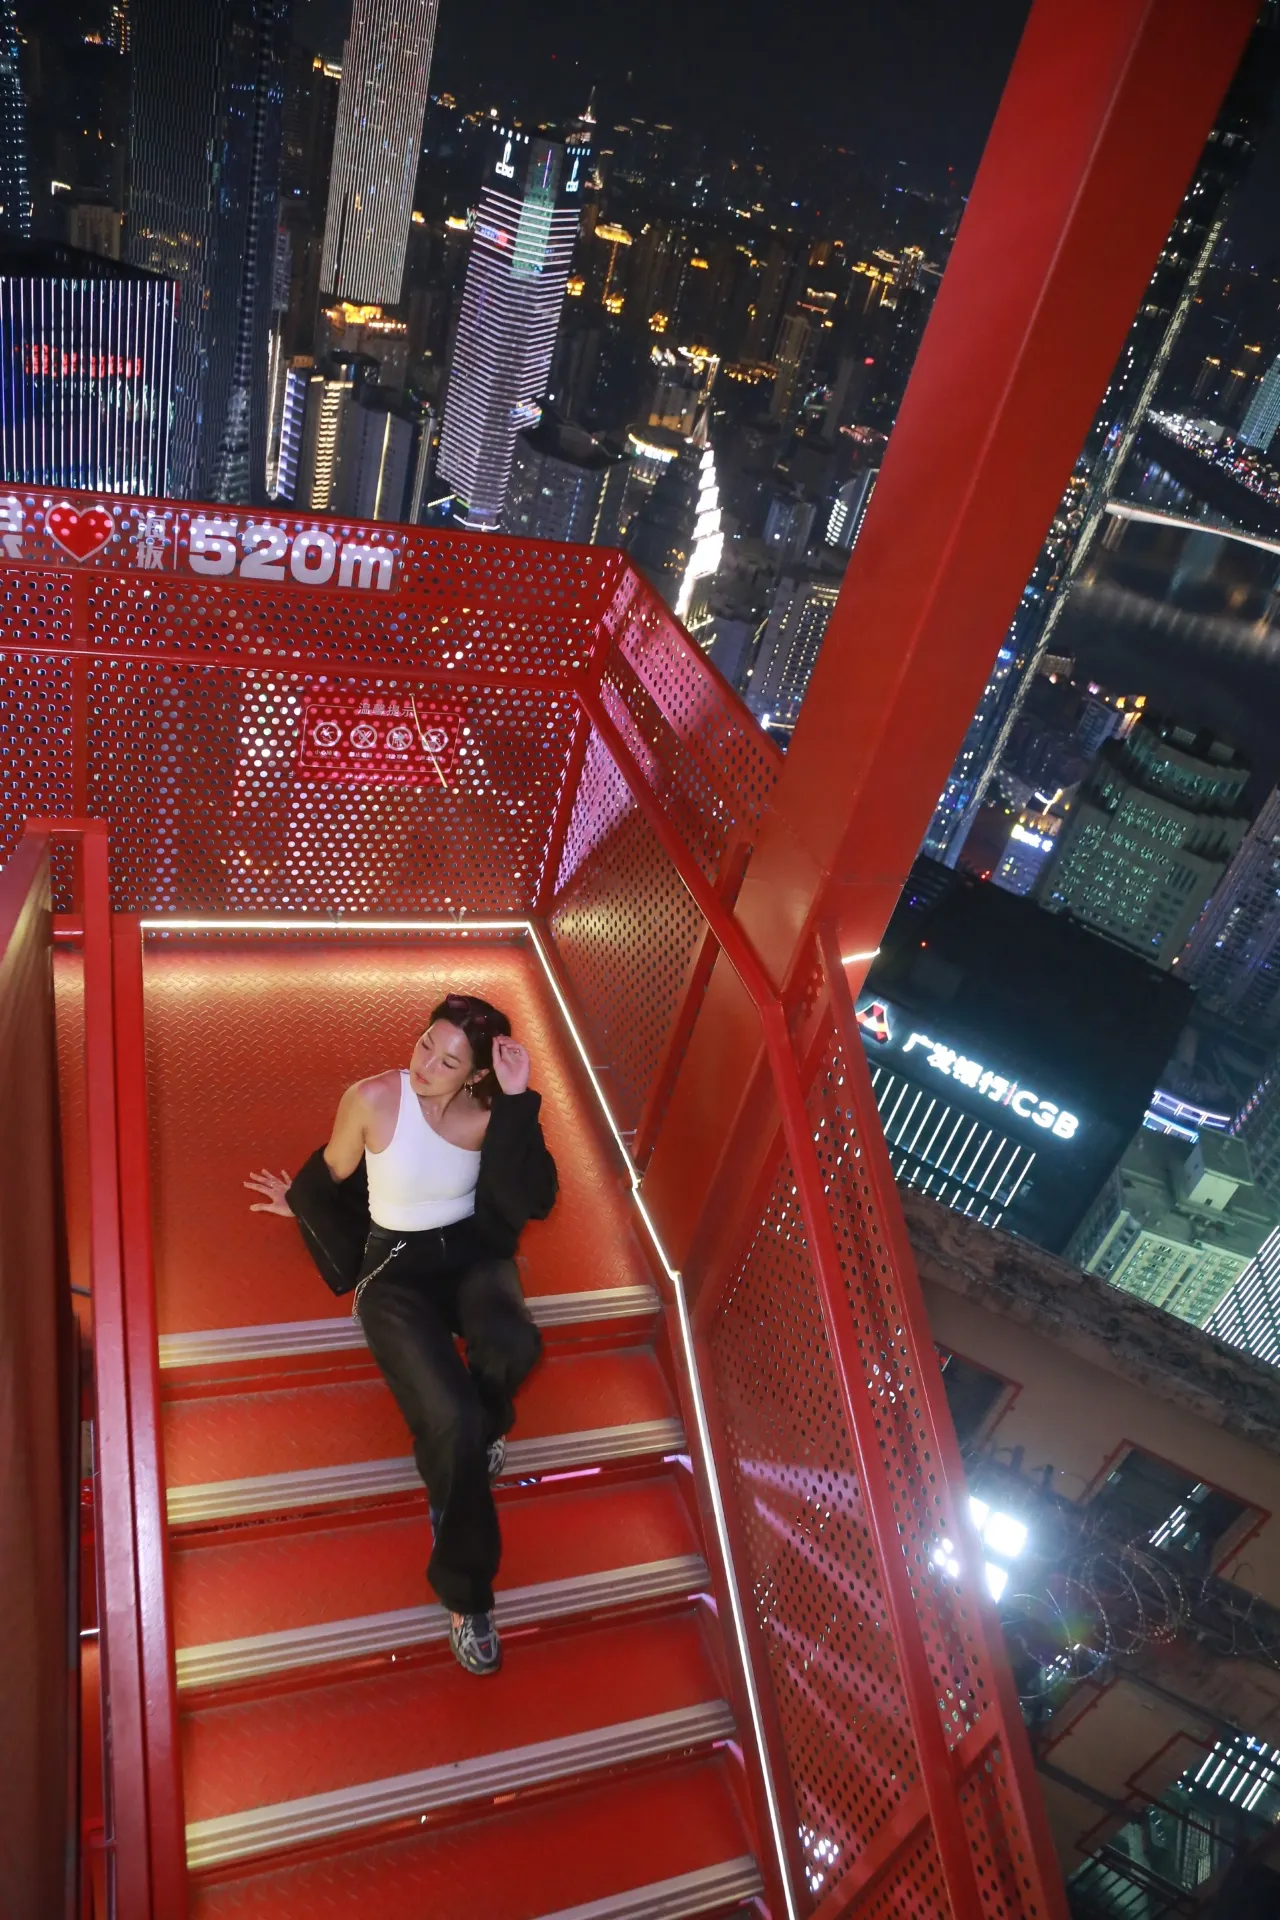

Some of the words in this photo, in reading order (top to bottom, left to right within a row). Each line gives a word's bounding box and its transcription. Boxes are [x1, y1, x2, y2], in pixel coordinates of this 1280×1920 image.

[188, 518, 394, 590] 520m
[903, 1033, 1009, 1102] 广发银行
